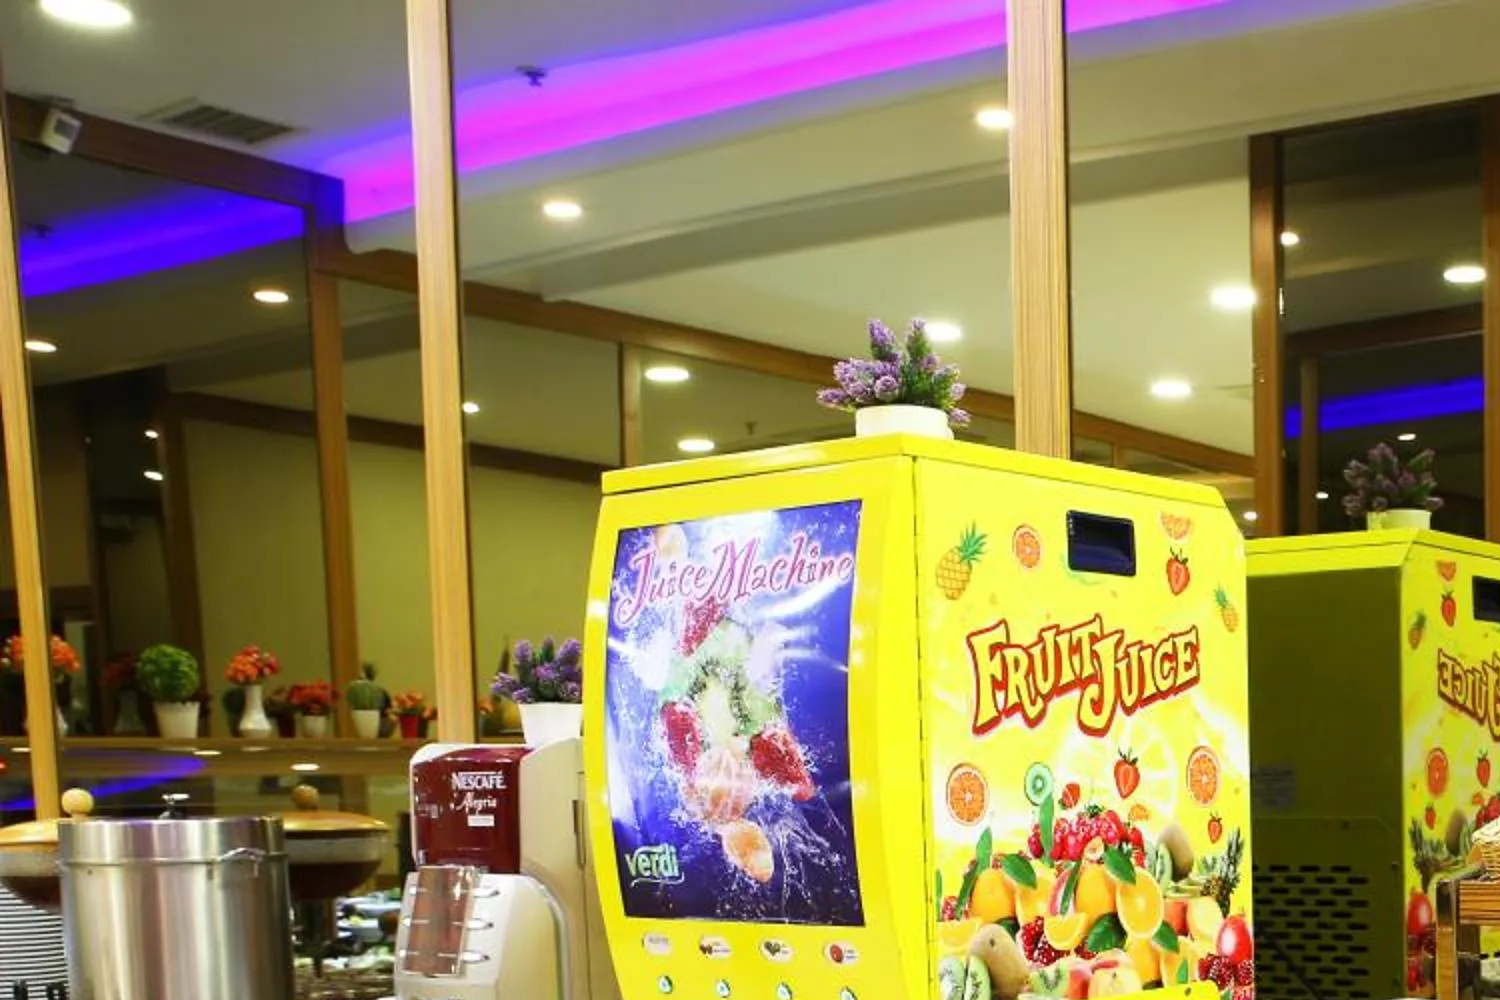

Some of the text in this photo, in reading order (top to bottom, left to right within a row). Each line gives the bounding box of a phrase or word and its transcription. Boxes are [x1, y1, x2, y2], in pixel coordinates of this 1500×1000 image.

[614, 532, 854, 628] Juice Machine
[966, 613, 1201, 737] FRUIT JUICE
[624, 844, 681, 880] verdi
